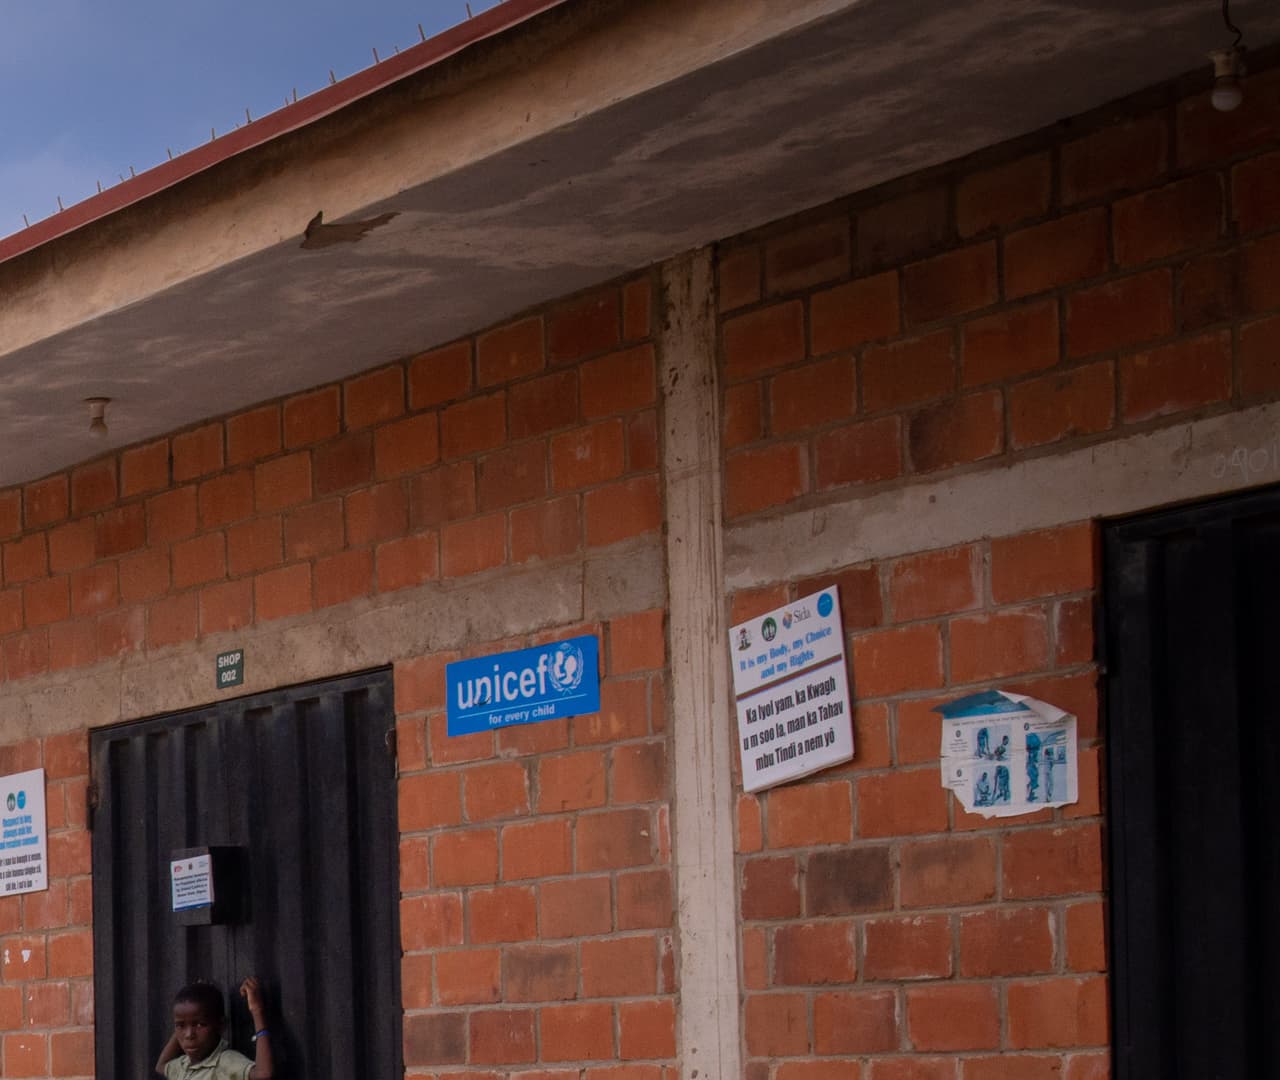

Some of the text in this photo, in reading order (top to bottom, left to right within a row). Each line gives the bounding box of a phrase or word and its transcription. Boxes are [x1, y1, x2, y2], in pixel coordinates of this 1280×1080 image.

[805, 626, 832, 644] Choice
[218, 653, 240, 667] SHOP
[789, 650, 814, 667] Rights
[222, 670, 236, 682] 002
[458, 654, 548, 709] unicef
[745, 707, 757, 724] Ka
[795, 689, 806, 705] ka
[806, 676, 836, 701] Kwagh
[489, 704, 555, 725] for every child
[759, 727, 775, 744] soo
[787, 716, 806, 734] man
[806, 711, 818, 726] ka
[755, 753, 775, 771] mbu
[775, 742, 797, 764] Tindi
[797, 742, 804, 756] a
[804, 734, 824, 753] nem
